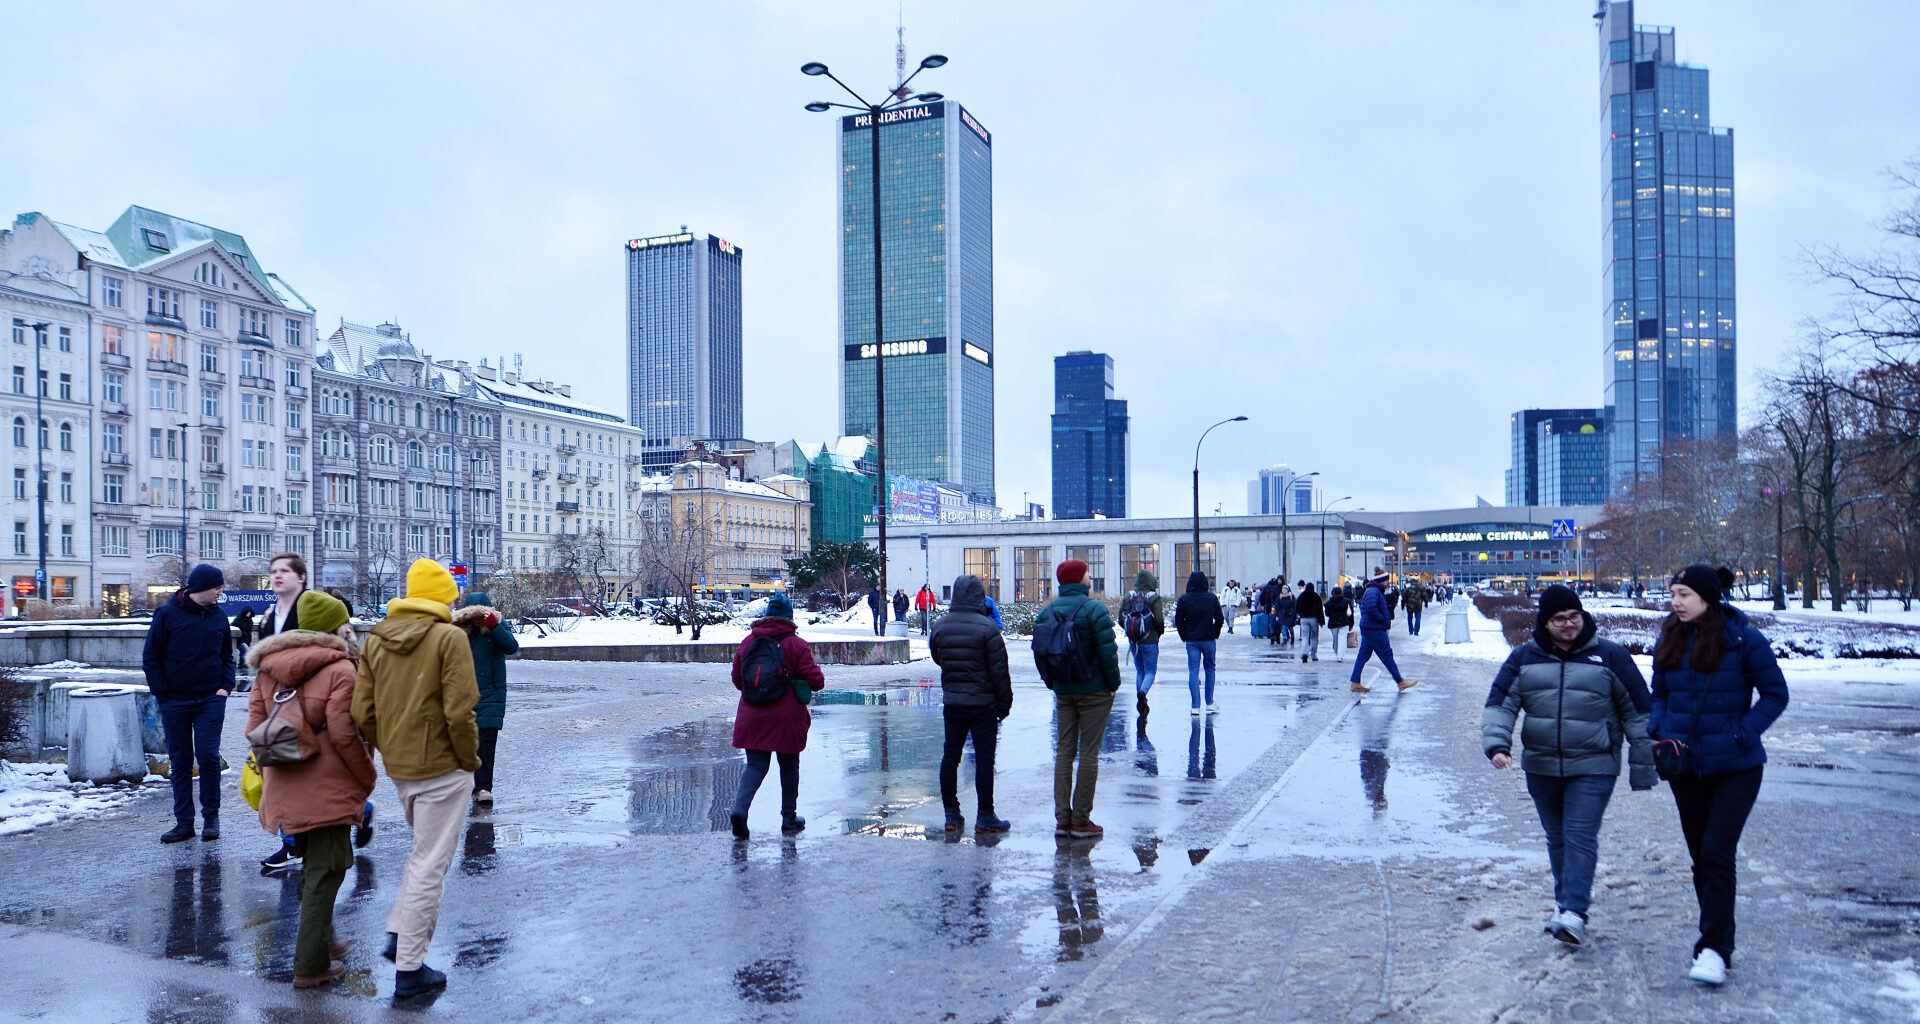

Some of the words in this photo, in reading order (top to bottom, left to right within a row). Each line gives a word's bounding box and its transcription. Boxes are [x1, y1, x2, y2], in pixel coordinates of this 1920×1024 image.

[855, 106, 932, 127] PREIDENTIAL
[1425, 532, 1483, 542] WARSZAWA
[36, 570, 43, 580] P
[228, 594, 264, 602] WARSZAWA
[264, 592, 278, 602] ŚRÓ
